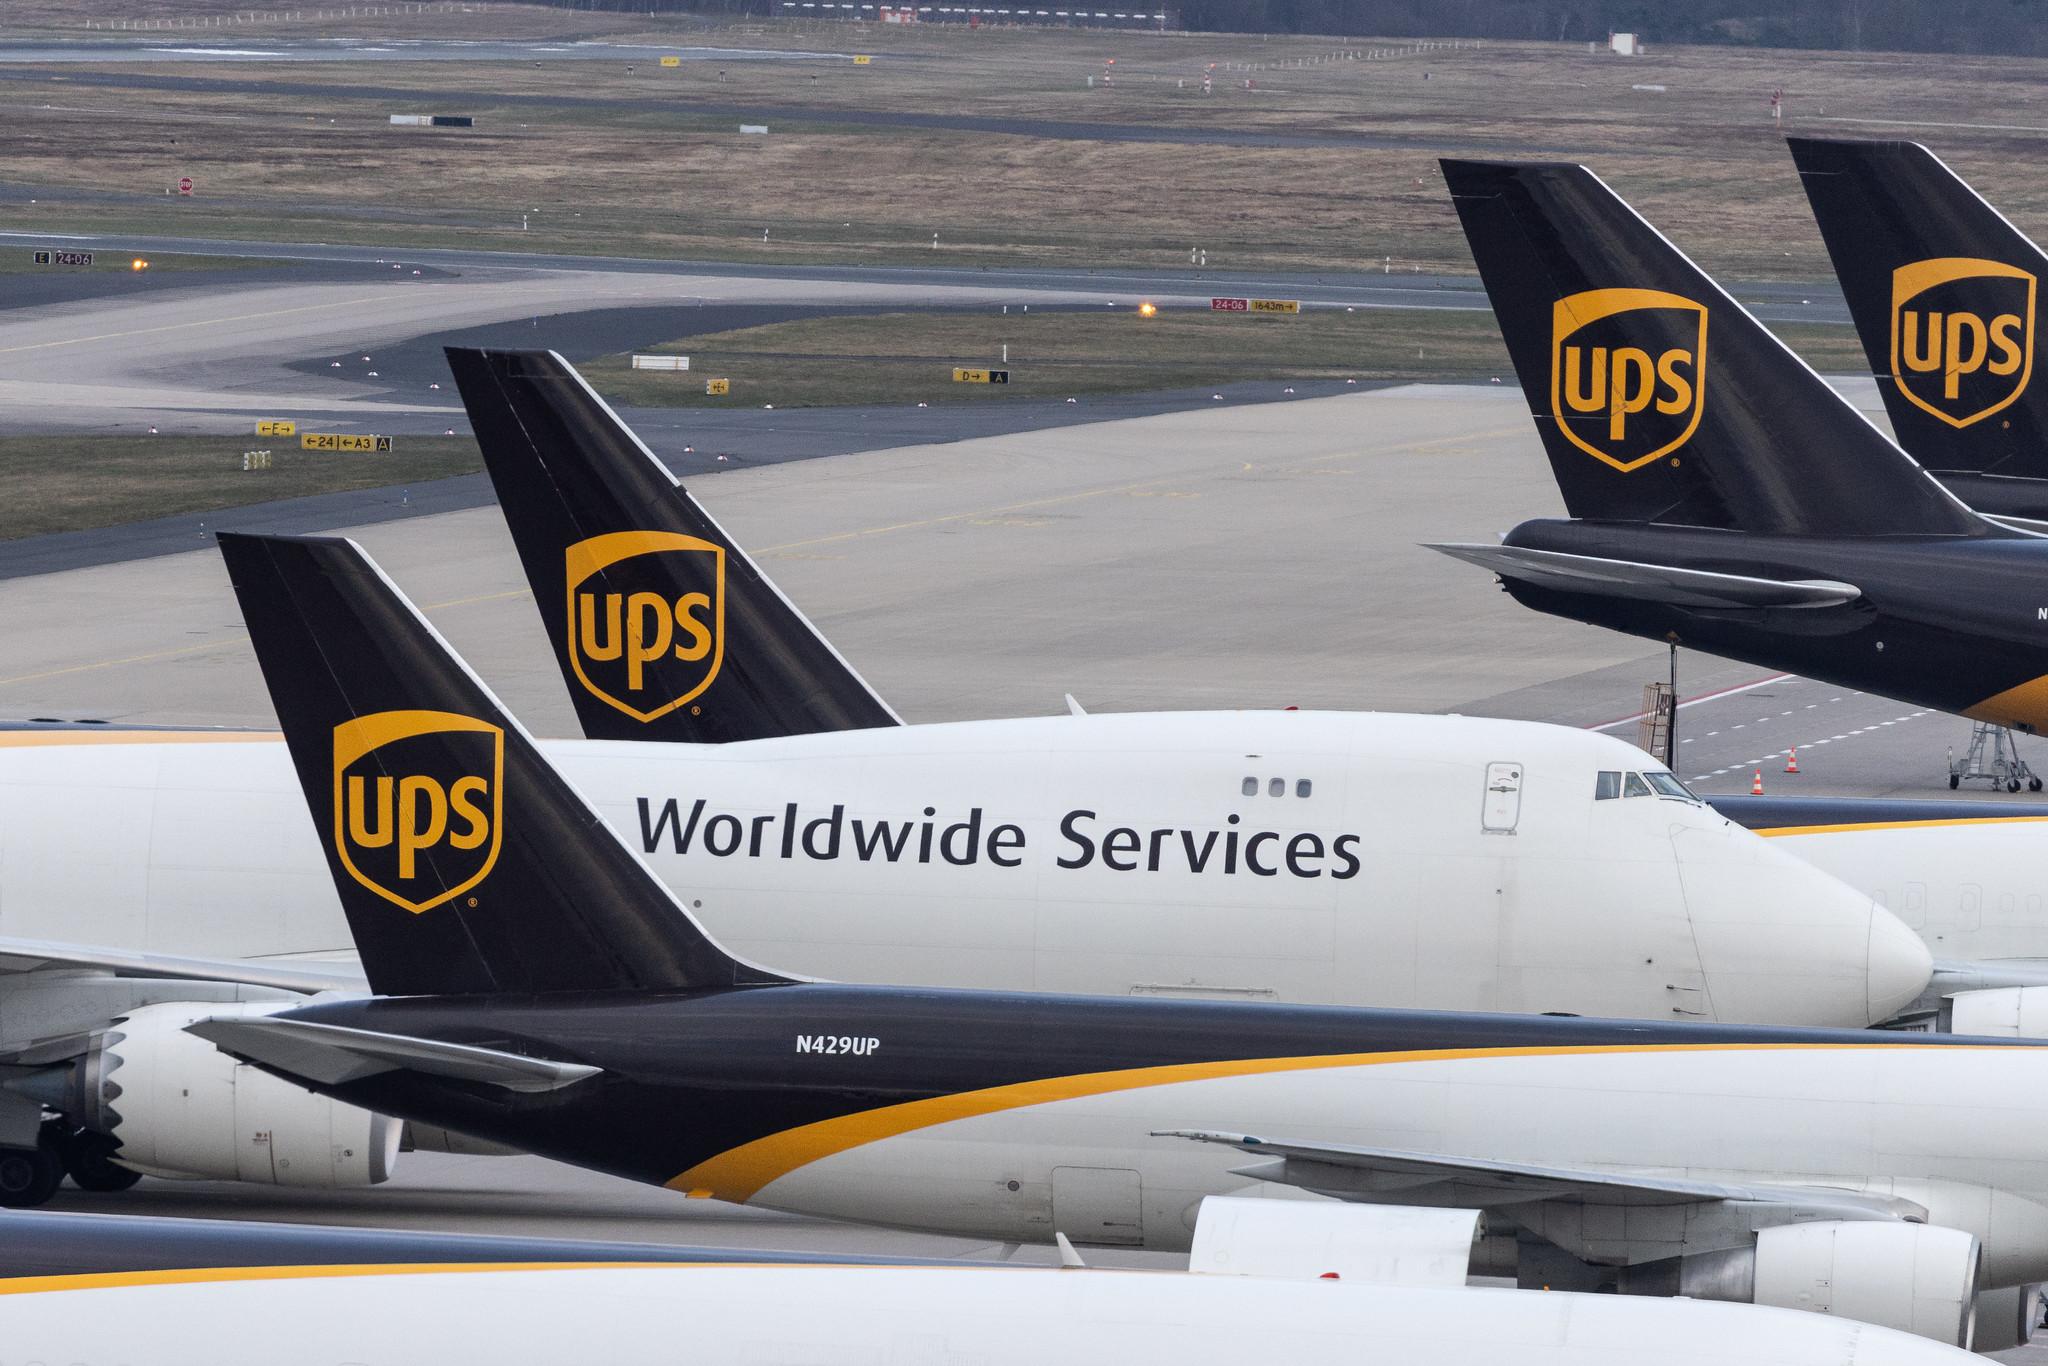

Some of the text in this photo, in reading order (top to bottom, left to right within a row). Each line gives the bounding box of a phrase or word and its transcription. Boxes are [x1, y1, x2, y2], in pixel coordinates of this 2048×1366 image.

[58, 253, 90, 265] 24-06
[1215, 300, 1284, 311] 24-06 1643m
[1904, 312, 2021, 399] ups
[962, 371, 1003, 383] D A
[1566, 347, 1692, 440] ups
[272, 423, 280, 436] E
[318, 436, 388, 450] 24 A3 A
[581, 592, 711, 689] ups
[349, 776, 488, 878] ups
[637, 797, 1361, 880] Worldwide Services
[796, 1034, 880, 1056] N429UP
